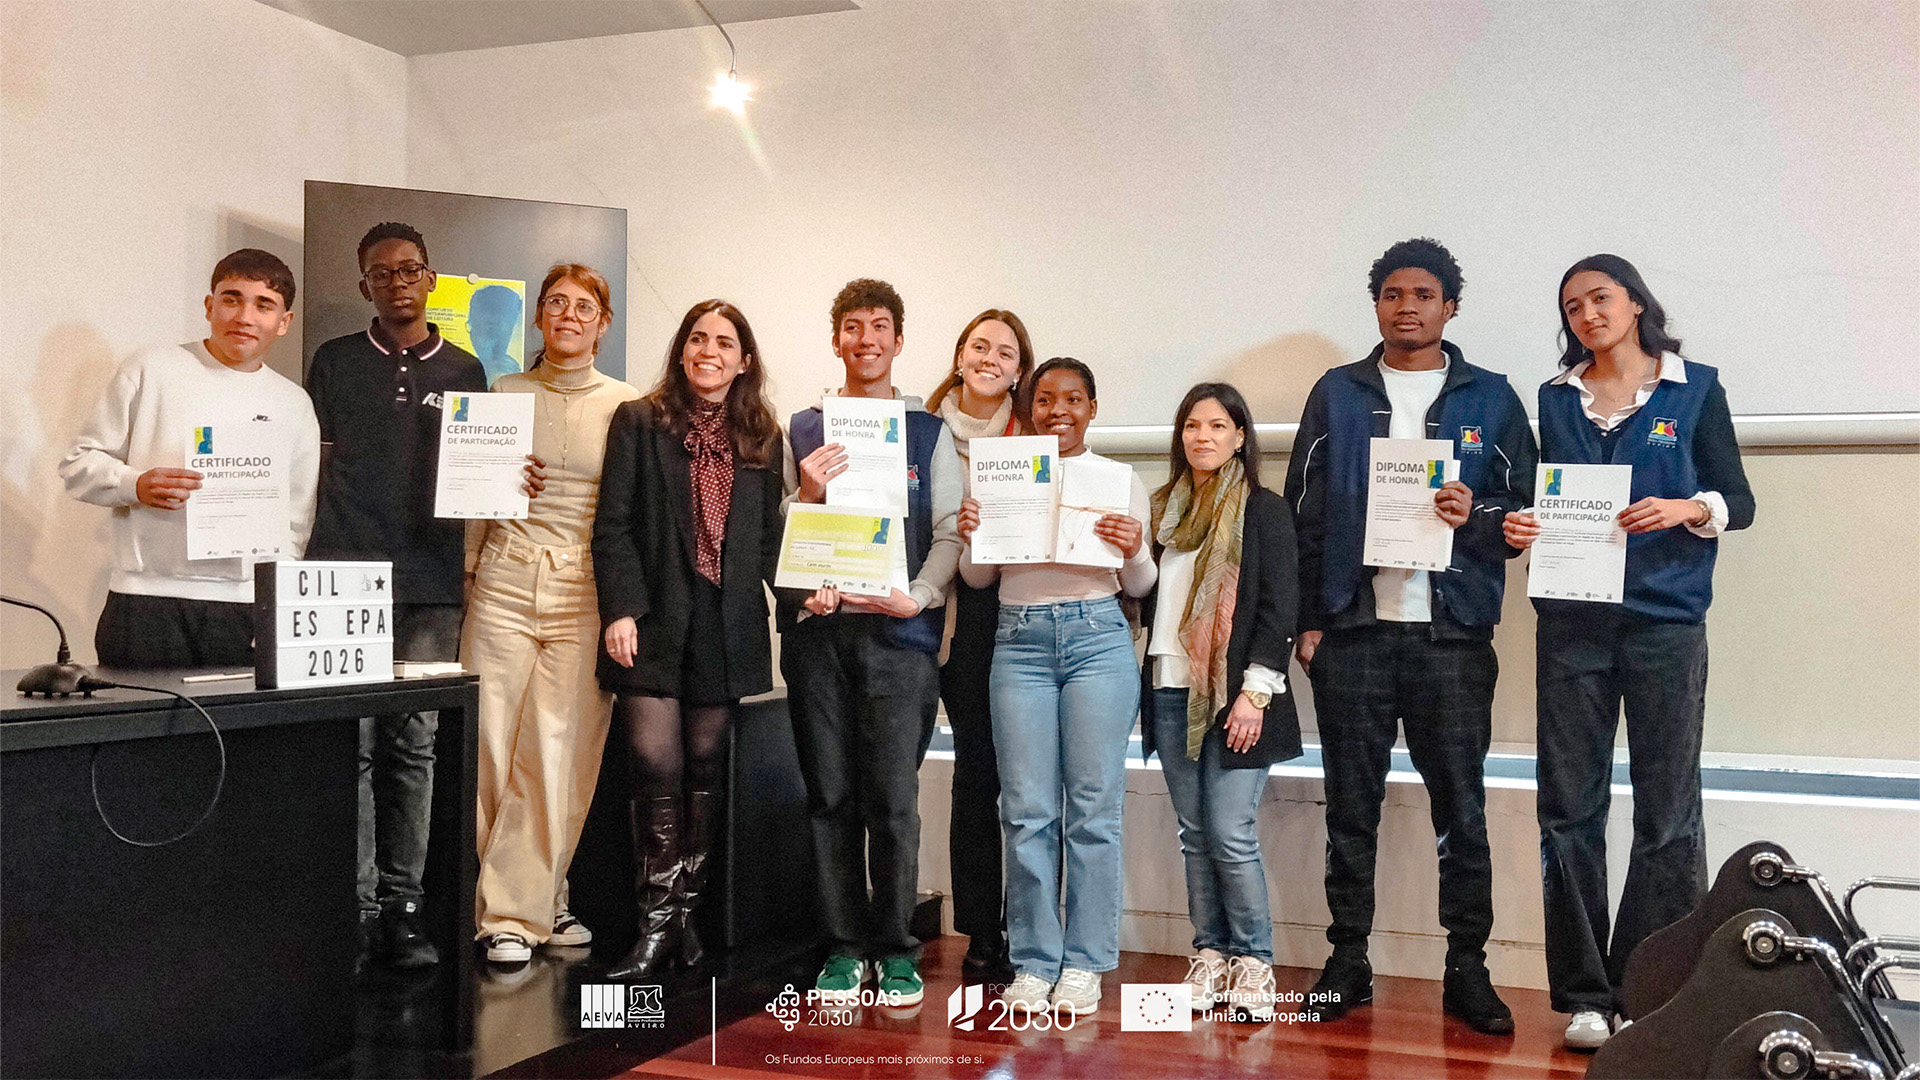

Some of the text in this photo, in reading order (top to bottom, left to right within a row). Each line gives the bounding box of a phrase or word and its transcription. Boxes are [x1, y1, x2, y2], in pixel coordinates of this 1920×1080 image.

[831, 418, 880, 429] DIPLOMA
[447, 425, 518, 435] CERTIFICADO
[846, 430, 875, 439] HONRA
[460, 437, 516, 446] PARTICIPAÇÃO
[192, 457, 271, 468] CERTIFICADO
[977, 460, 1030, 471] DIPLOMA
[1376, 461, 1425, 474] DIPLOMA
[207, 469, 270, 479] PARTICIPAÇÃO
[992, 473, 1024, 482] HONRA
[1376, 475, 1419, 485] DE HONRA
[1540, 498, 1613, 511] CERTIFICADO
[1540, 512, 1610, 523] DE PARTICIPAÇÃO
[299, 570, 338, 596] CIL
[293, 609, 385, 637] ES EPA
[309, 648, 364, 676] 2026
